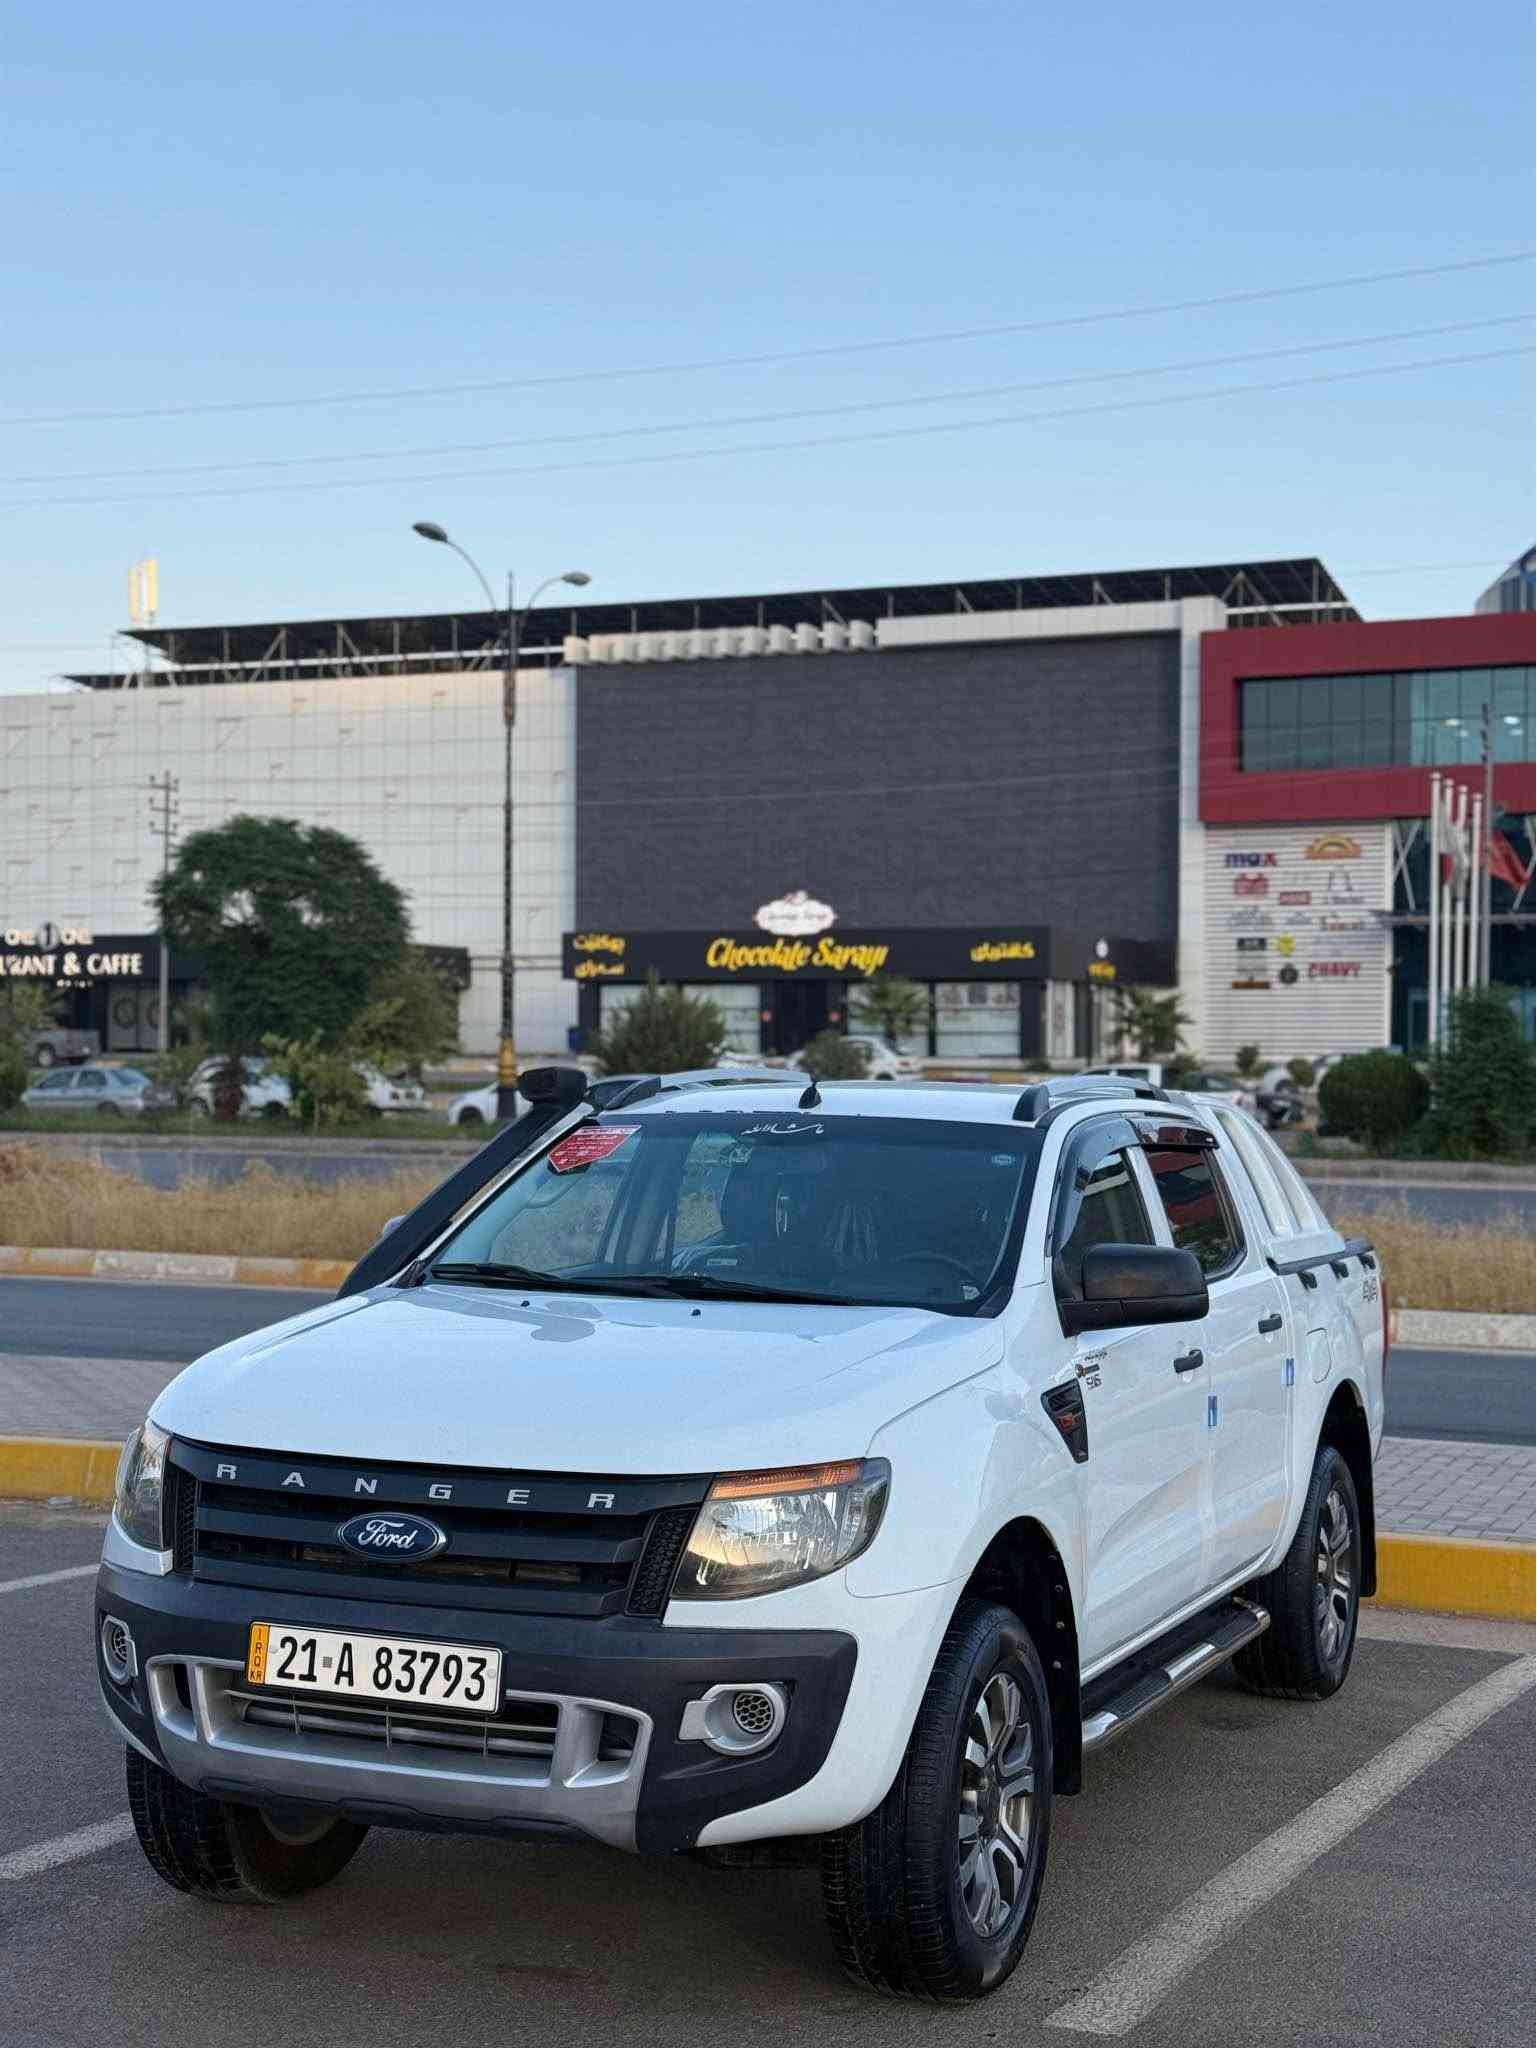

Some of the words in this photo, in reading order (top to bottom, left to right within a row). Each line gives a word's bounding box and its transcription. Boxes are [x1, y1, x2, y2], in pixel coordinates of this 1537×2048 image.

[63, 951, 80, 976] &
[86, 952, 143, 976] CAFFE
[706, 937, 811, 972] Chocolate
[216, 1463, 616, 1509] RANGER
[357, 1518, 416, 1550] Ford
[276, 1635, 318, 1683] 21
[334, 1641, 354, 1688] A
[372, 1645, 488, 1702] 83793
